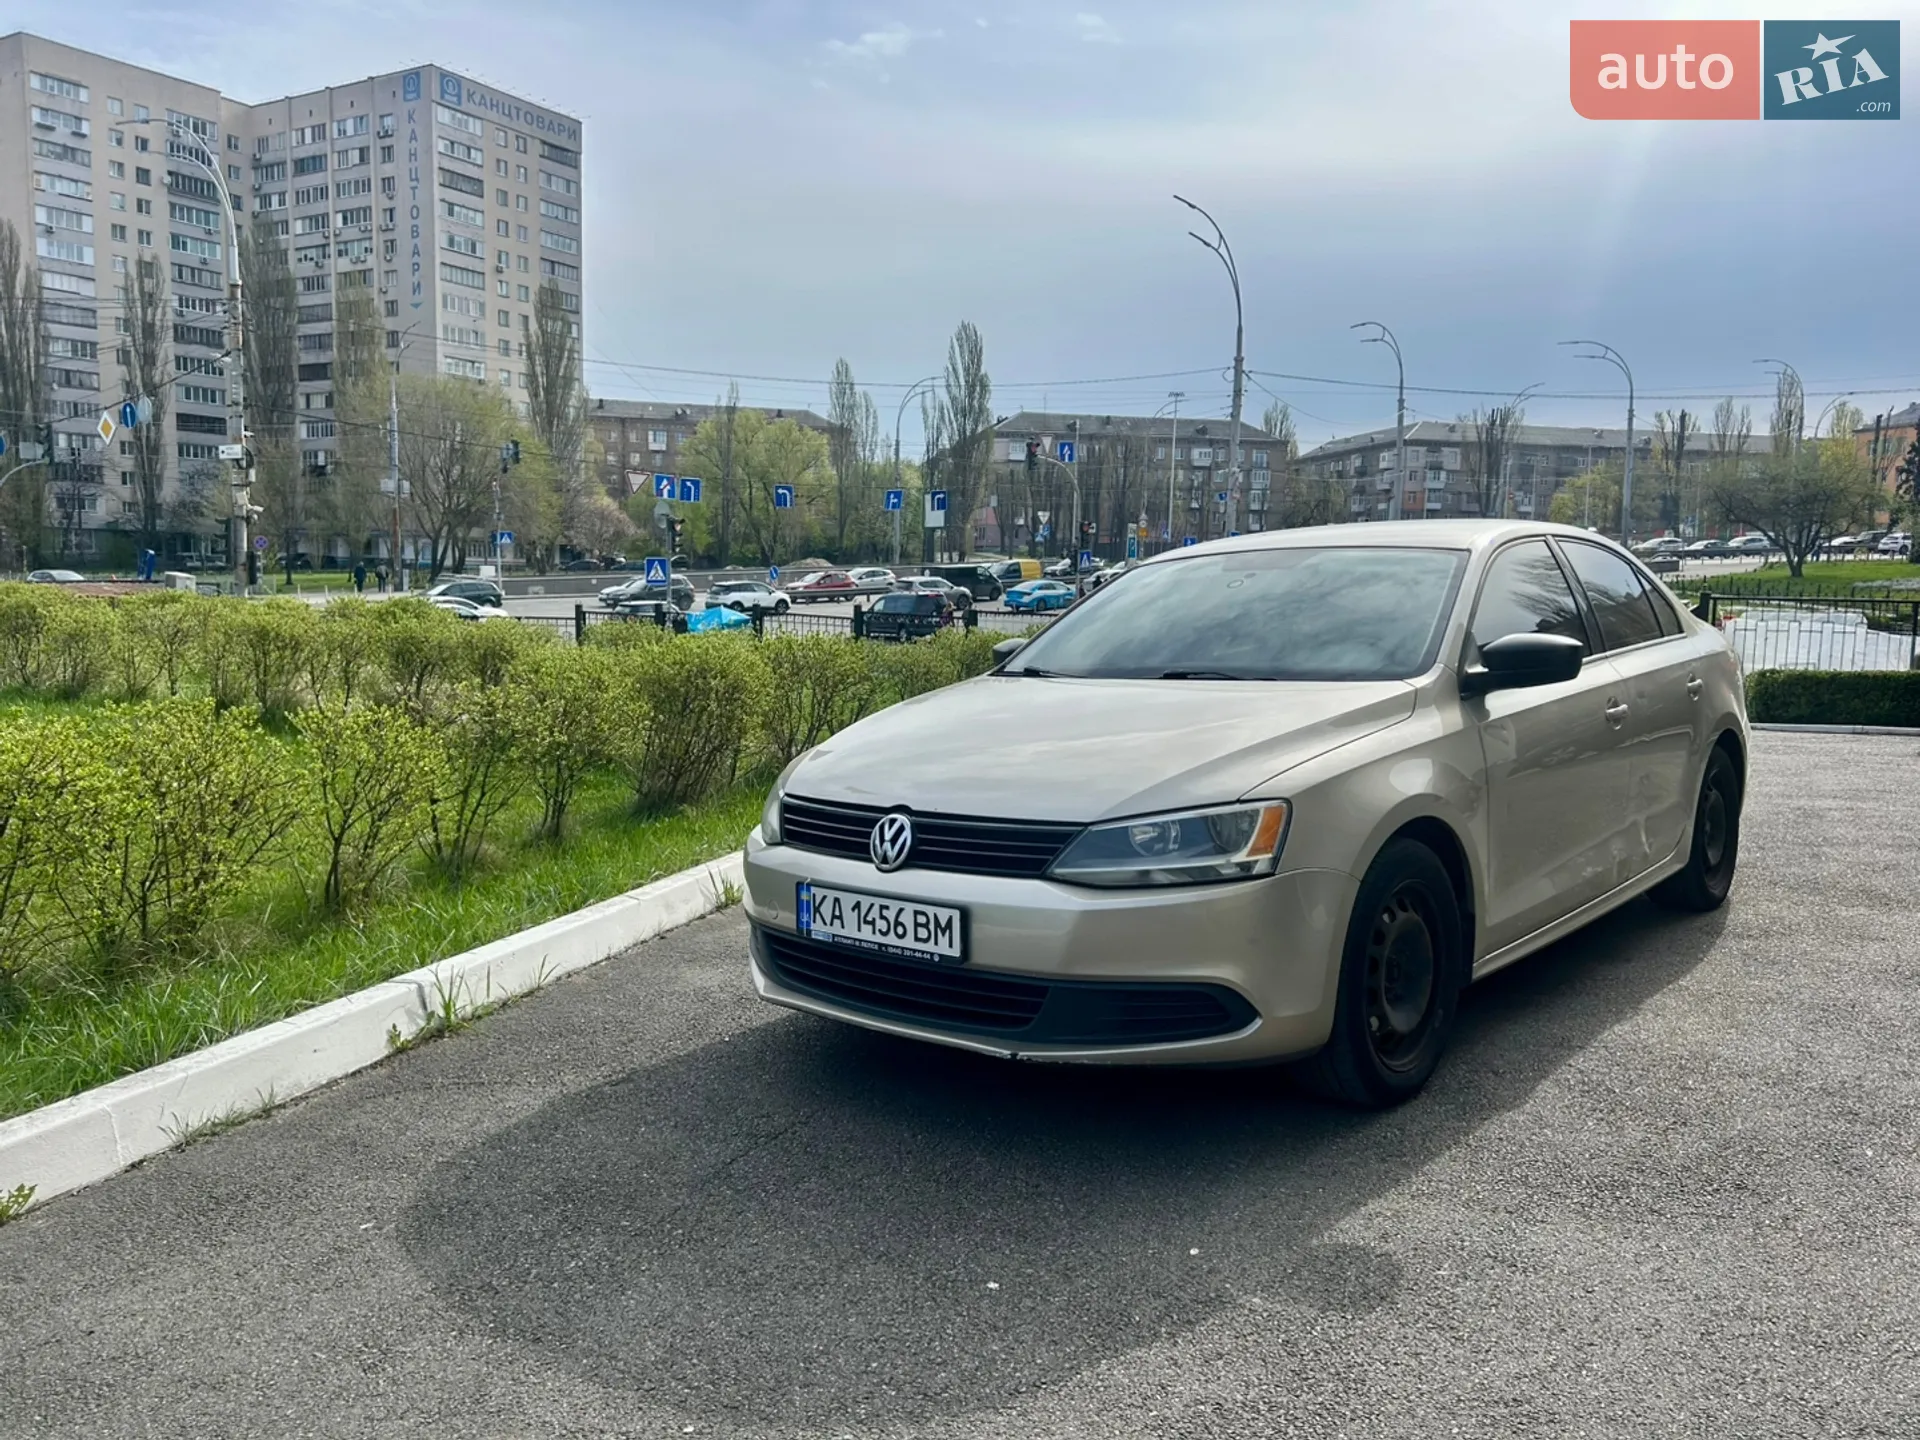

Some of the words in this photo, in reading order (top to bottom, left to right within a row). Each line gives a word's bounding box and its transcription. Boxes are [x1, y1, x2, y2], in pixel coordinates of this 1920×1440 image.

[466, 88, 578, 142] КАНЦТОВАРИ
[407, 108, 422, 296] КАНЦТОВАРИ
[812, 892, 845, 930] KA
[851, 900, 907, 940] 1456
[913, 909, 953, 949] BM
